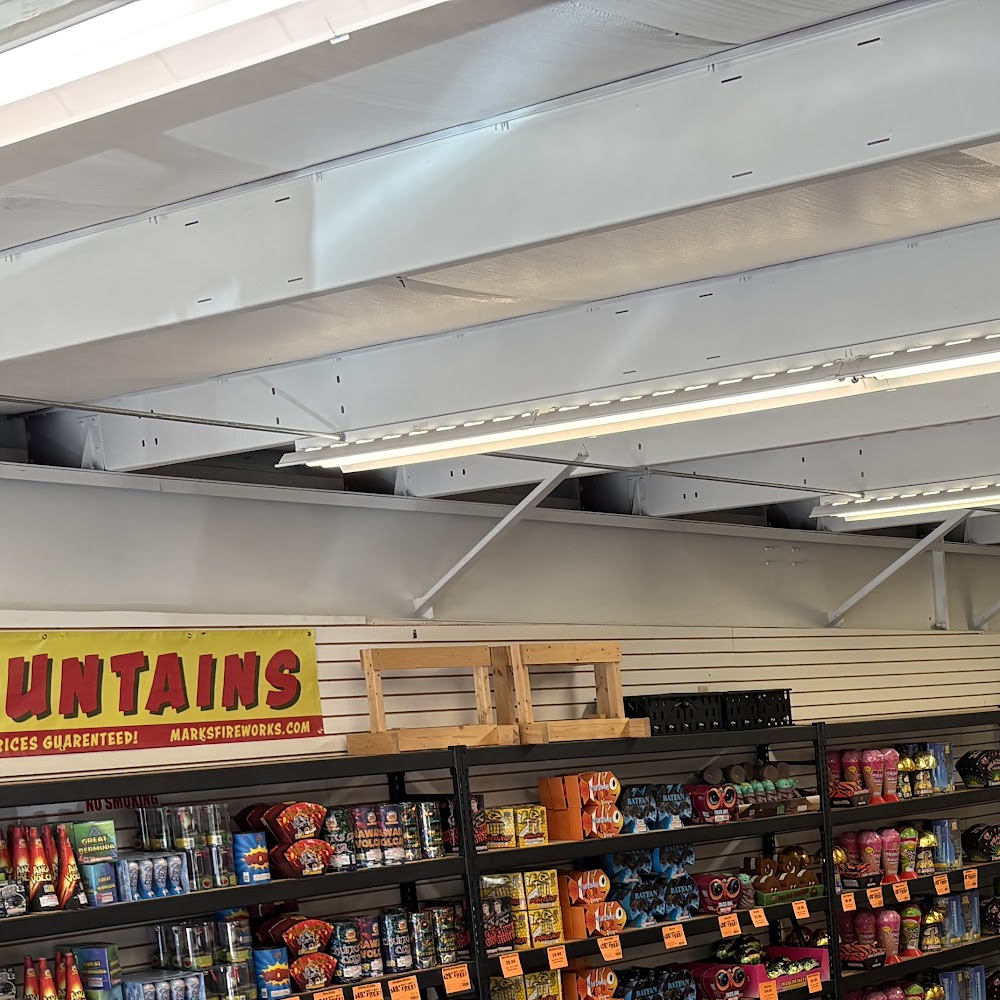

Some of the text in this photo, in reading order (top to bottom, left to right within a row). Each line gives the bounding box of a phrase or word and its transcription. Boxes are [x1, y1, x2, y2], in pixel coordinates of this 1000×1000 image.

[5, 649, 301, 723] UNTAINS
[43, 731, 139, 752] GUARENTEED!
[169, 720, 311, 743] MARKSFIREWORKS.COM
[81, 834, 108, 845] GREAT
